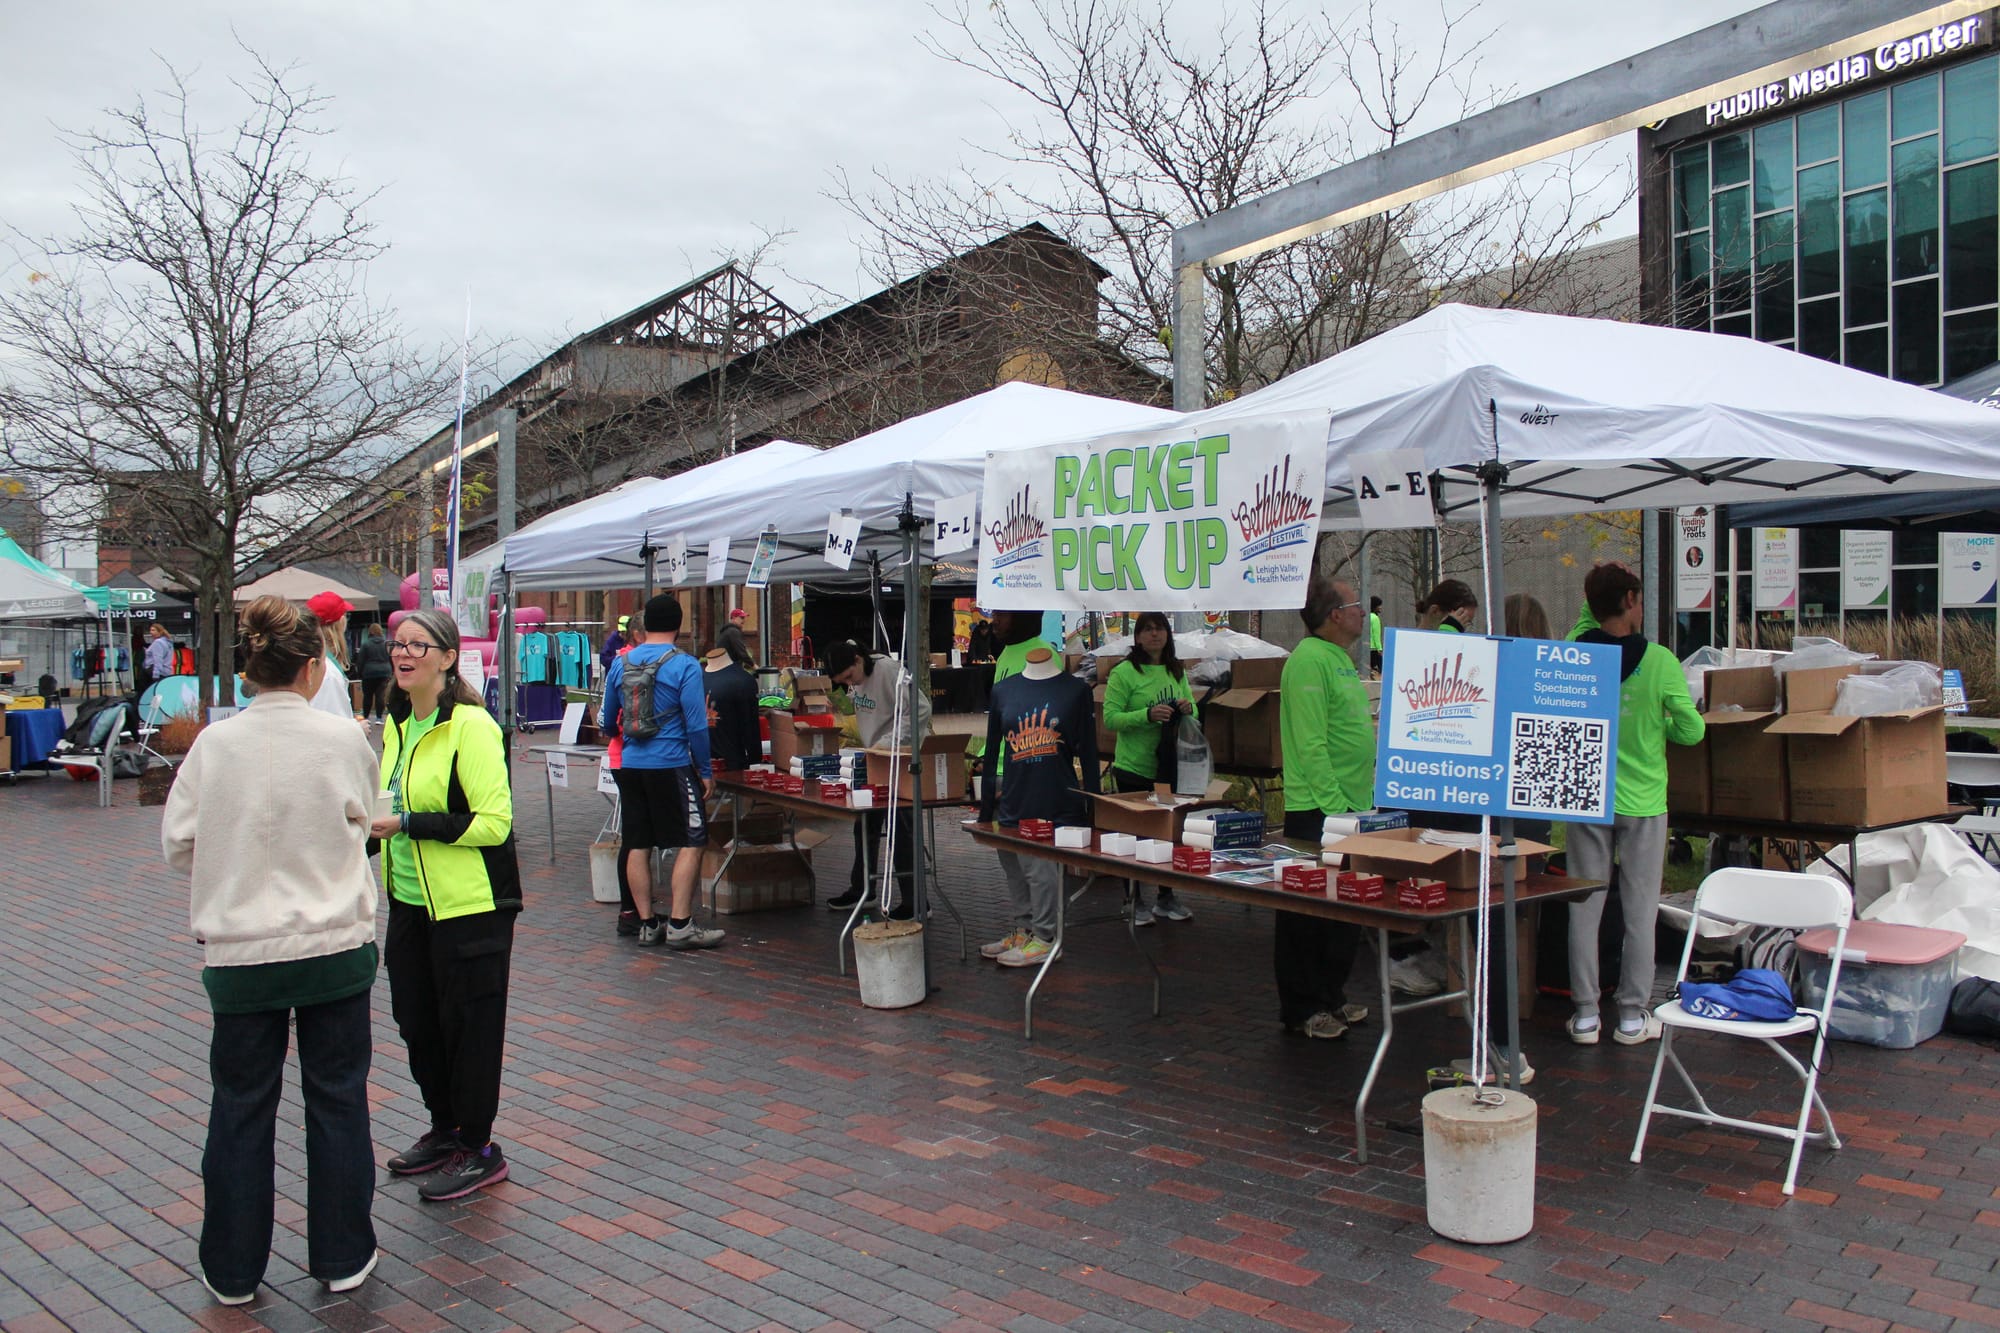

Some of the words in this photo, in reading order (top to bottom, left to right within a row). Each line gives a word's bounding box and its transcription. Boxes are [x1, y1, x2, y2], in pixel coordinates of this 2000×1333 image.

[1705, 83, 1783, 126] Public
[1788, 56, 1870, 100] Media
[1875, 15, 1981, 72] Center
[1520, 412, 1560, 426] QUEST
[1053, 433, 1230, 519] PACKET
[1359, 475, 1380, 499] A
[1406, 471, 1426, 496] E
[1231, 454, 1317, 542] Bethlehem
[984, 483, 1050, 554] Bethlehem
[1681, 516, 1706, 528] finding
[1682, 526, 1699, 535] your
[1242, 540, 1269, 556] RUNNING
[1271, 528, 1304, 545] FESTIVAL
[1967, 537, 1995, 546] MORE
[1051, 523, 1150, 591] PICK
[1164, 517, 1228, 590] UP
[1006, 572, 1023, 581] Lehigh
[1024, 572, 1037, 581] Valley
[1256, 564, 1279, 576] Lehigh
[1280, 564, 1299, 575] Valley
[1023, 580, 1042, 588] Network
[1256, 574, 1279, 584] Health
[1280, 572, 1304, 583] Network
[26, 599, 65, 608] LEADER
[1536, 645, 1591, 665] FAQs
[1398, 653, 1490, 710] Bethlehem
[1535, 669, 1552, 679] For
[1554, 670, 1597, 682] Runners
[1533, 682, 1588, 695] Spectators
[1590, 686, 1598, 696] &
[1533, 695, 1587, 708] Volunteers
[1440, 707, 1472, 716] FESTIVAL
[1421, 728, 1443, 738] Lehigh
[1444, 729, 1464, 738] Valley
[1421, 736, 1443, 744] Health
[1443, 737, 1472, 746] Network
[1387, 755, 1504, 781] Questions?
[1385, 782, 1436, 801] Scan
[1443, 786, 1490, 805] Here
